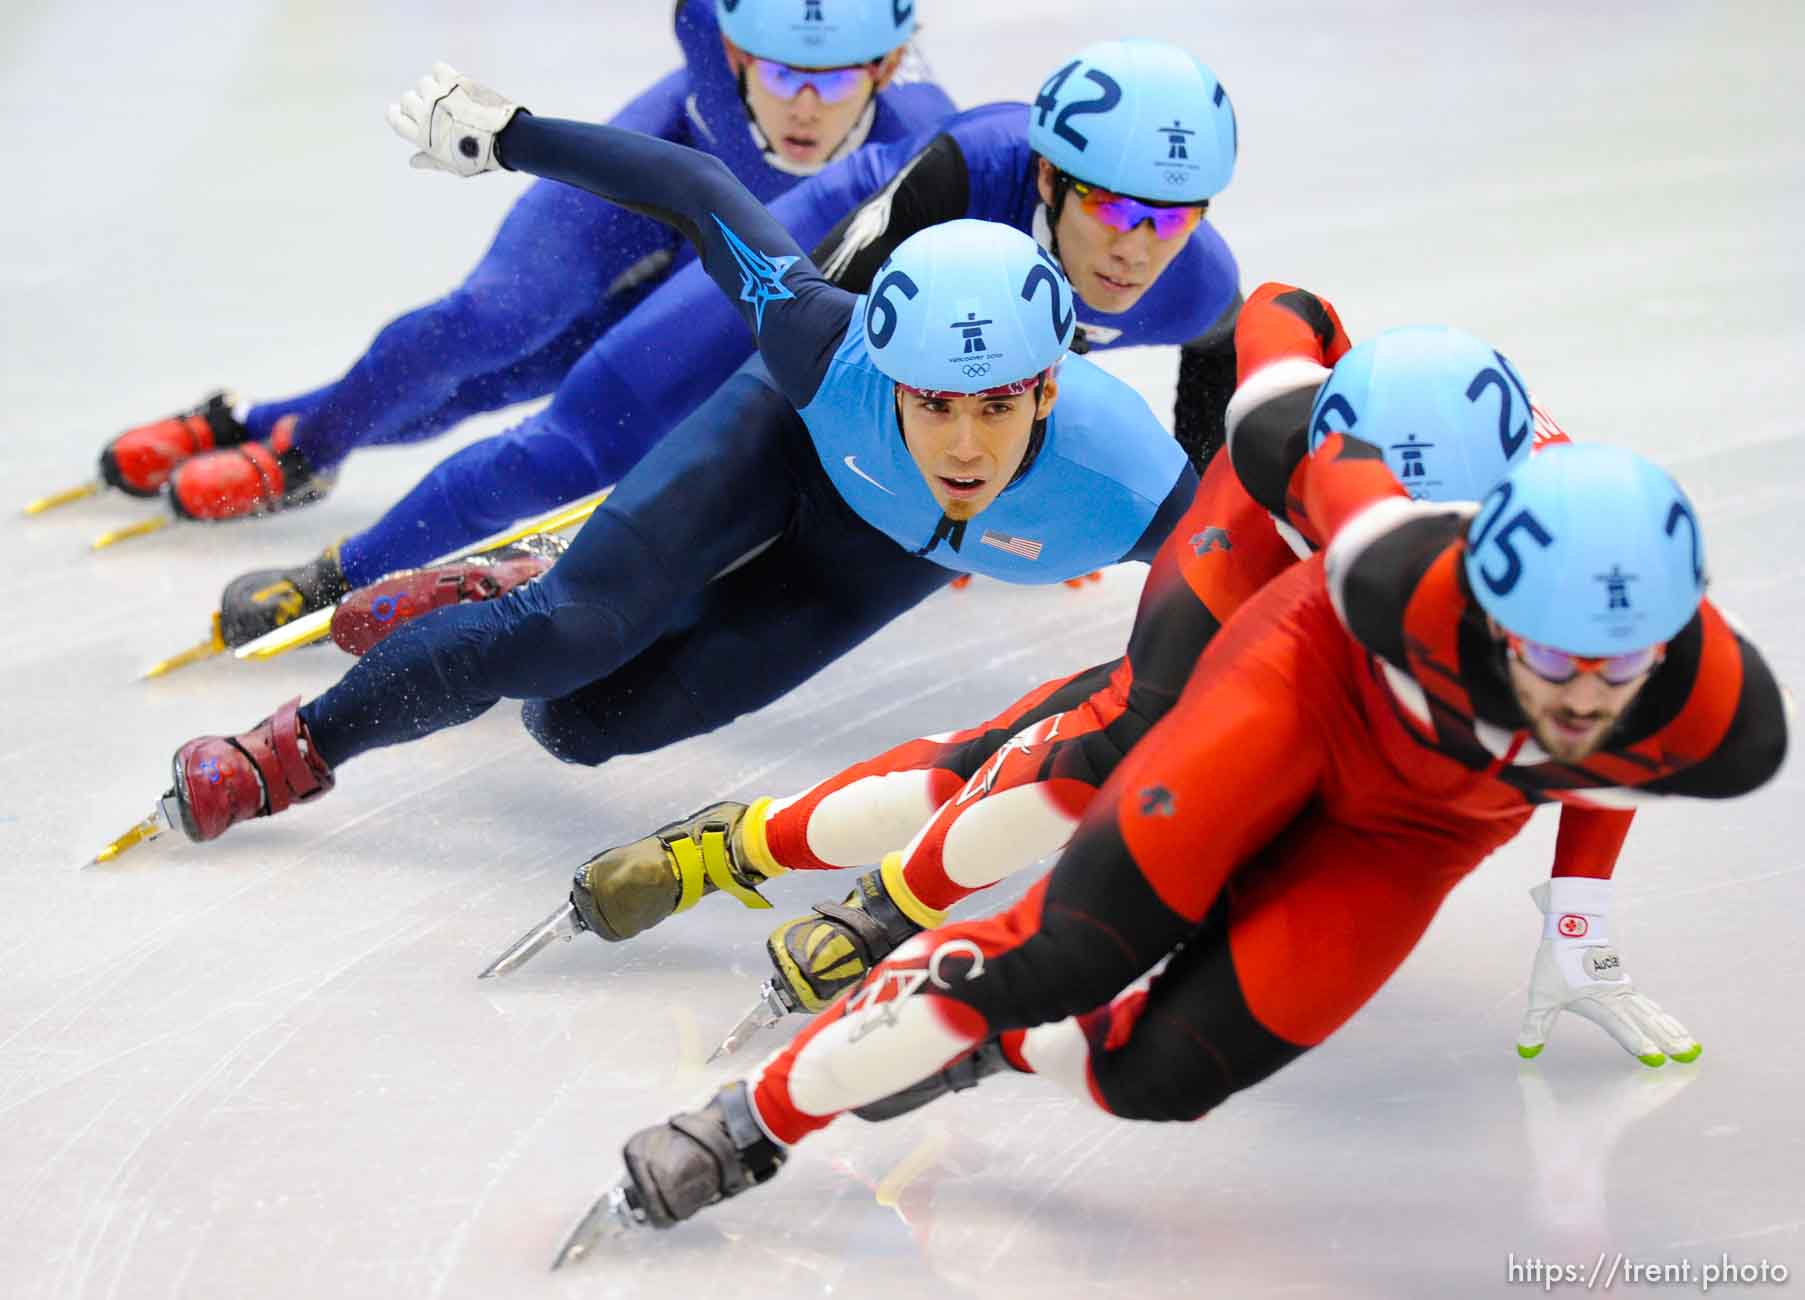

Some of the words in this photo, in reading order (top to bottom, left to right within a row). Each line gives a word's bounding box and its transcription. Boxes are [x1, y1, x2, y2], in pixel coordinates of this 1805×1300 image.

[1034, 59, 1122, 153] 42
[866, 257, 919, 350] 6
[1021, 243, 1073, 346] 2
